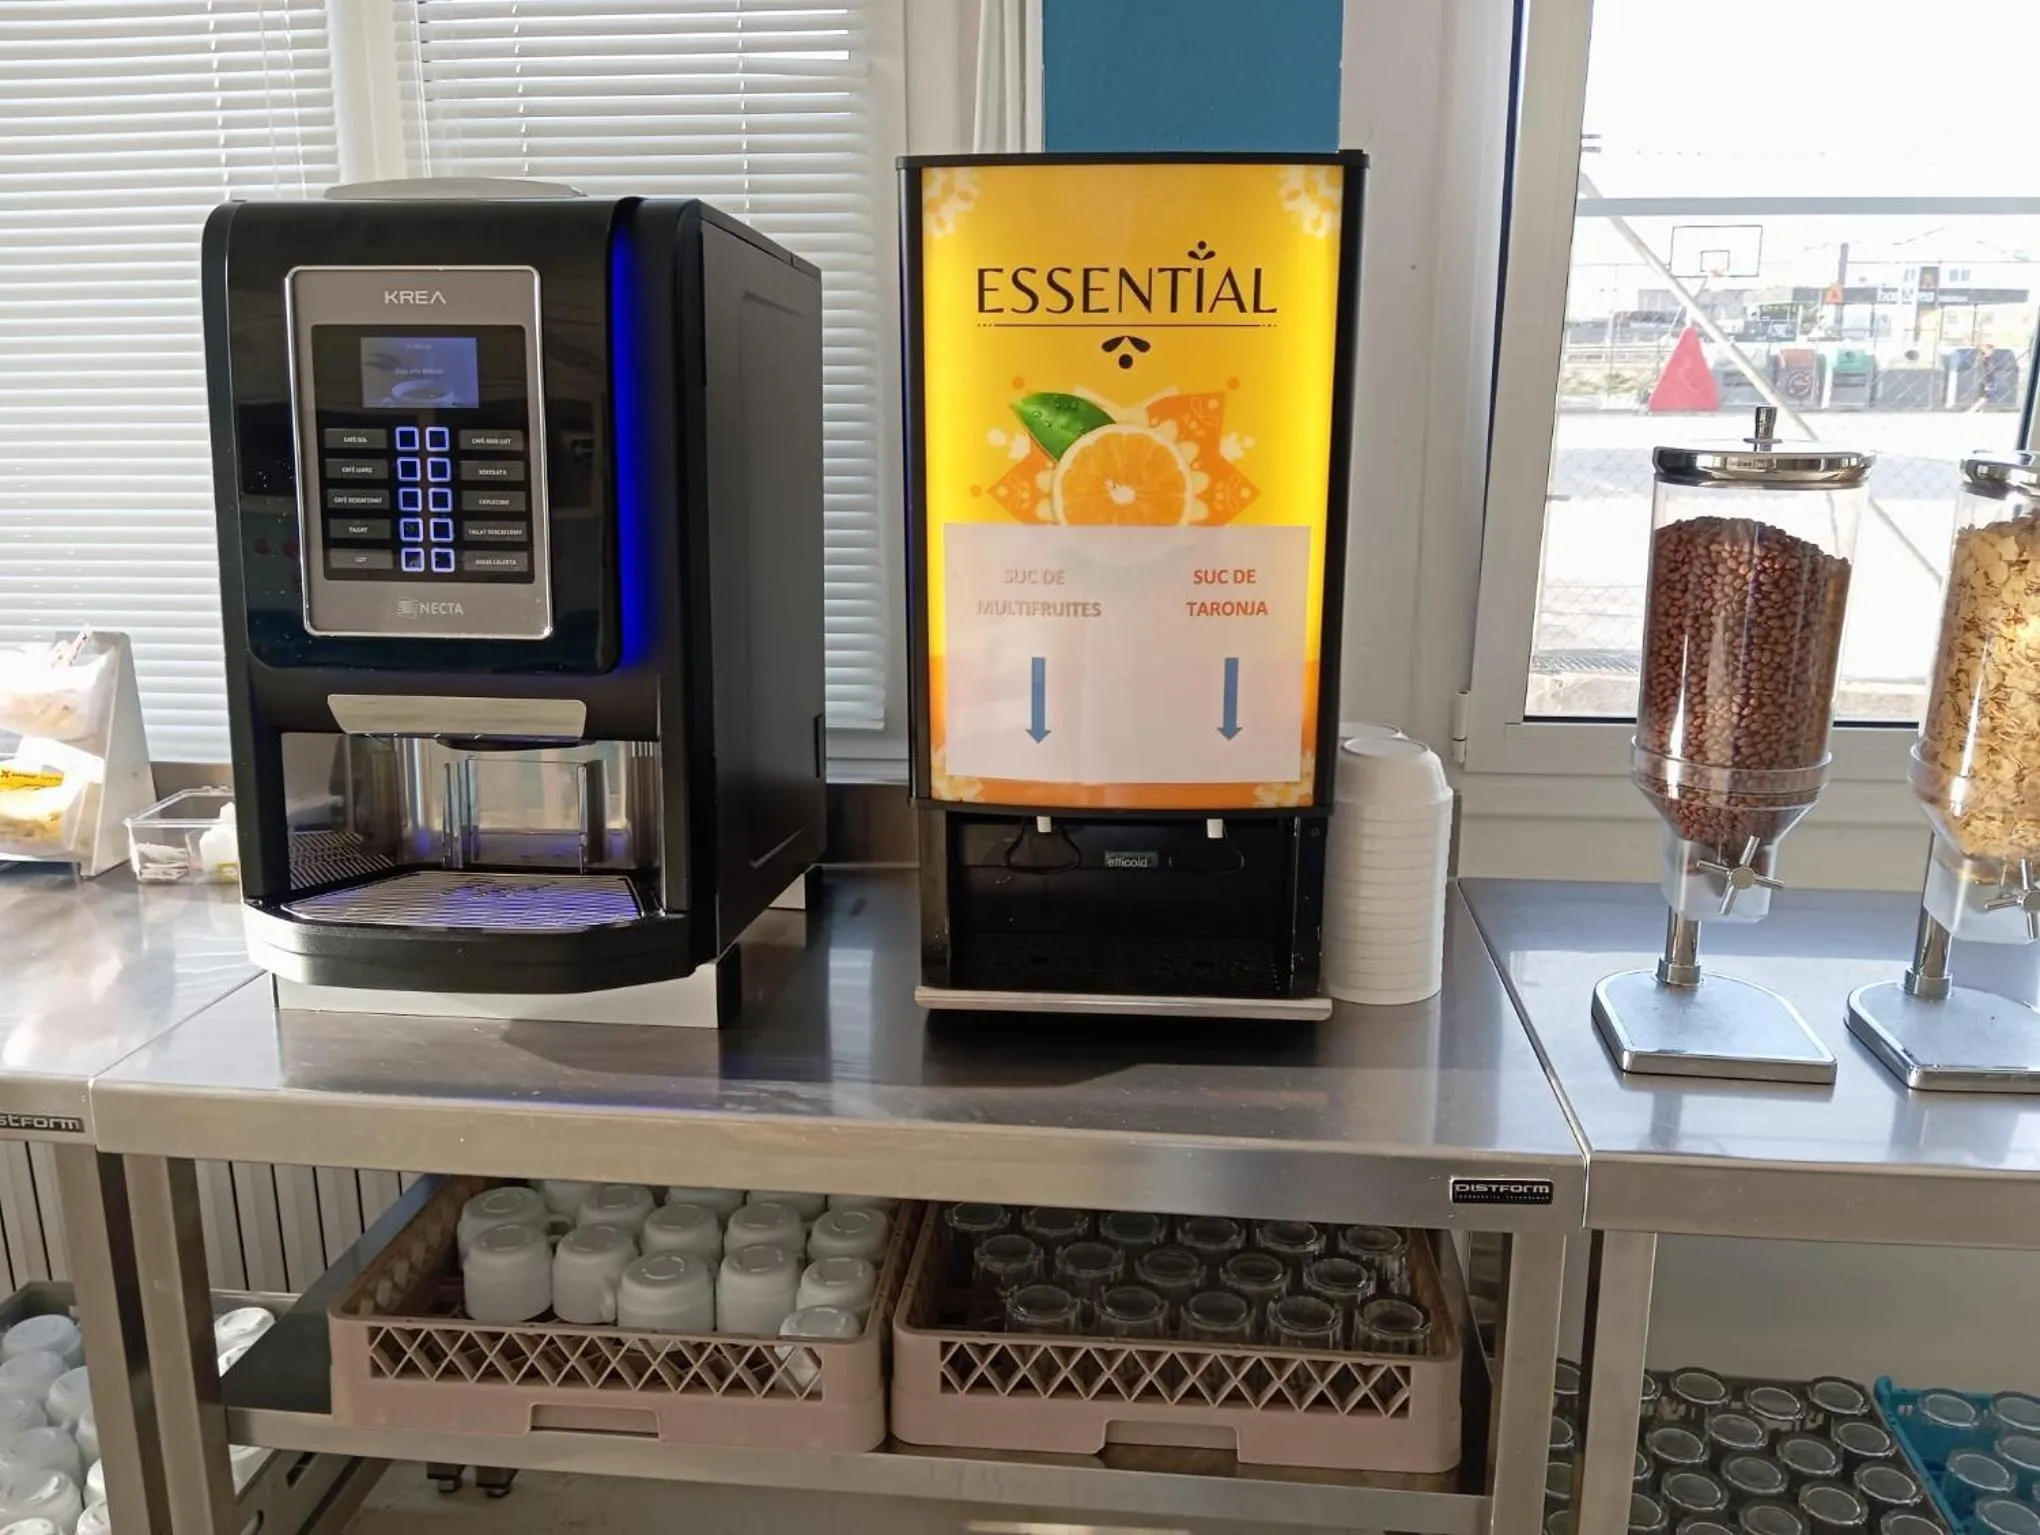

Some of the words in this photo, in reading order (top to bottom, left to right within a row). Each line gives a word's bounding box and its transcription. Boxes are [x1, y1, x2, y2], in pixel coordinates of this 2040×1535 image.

[977, 252, 1278, 314] ESSENTIAL
[384, 290, 446, 304] KREA
[1003, 569, 1037, 585] SUC
[1041, 570, 1066, 585] DE
[1193, 569, 1229, 585] SUC
[1233, 569, 1257, 584] DE
[420, 602, 465, 615] NECTA
[976, 600, 1102, 618] MULTIFRUITES
[1186, 601, 1269, 617] TARONJA
